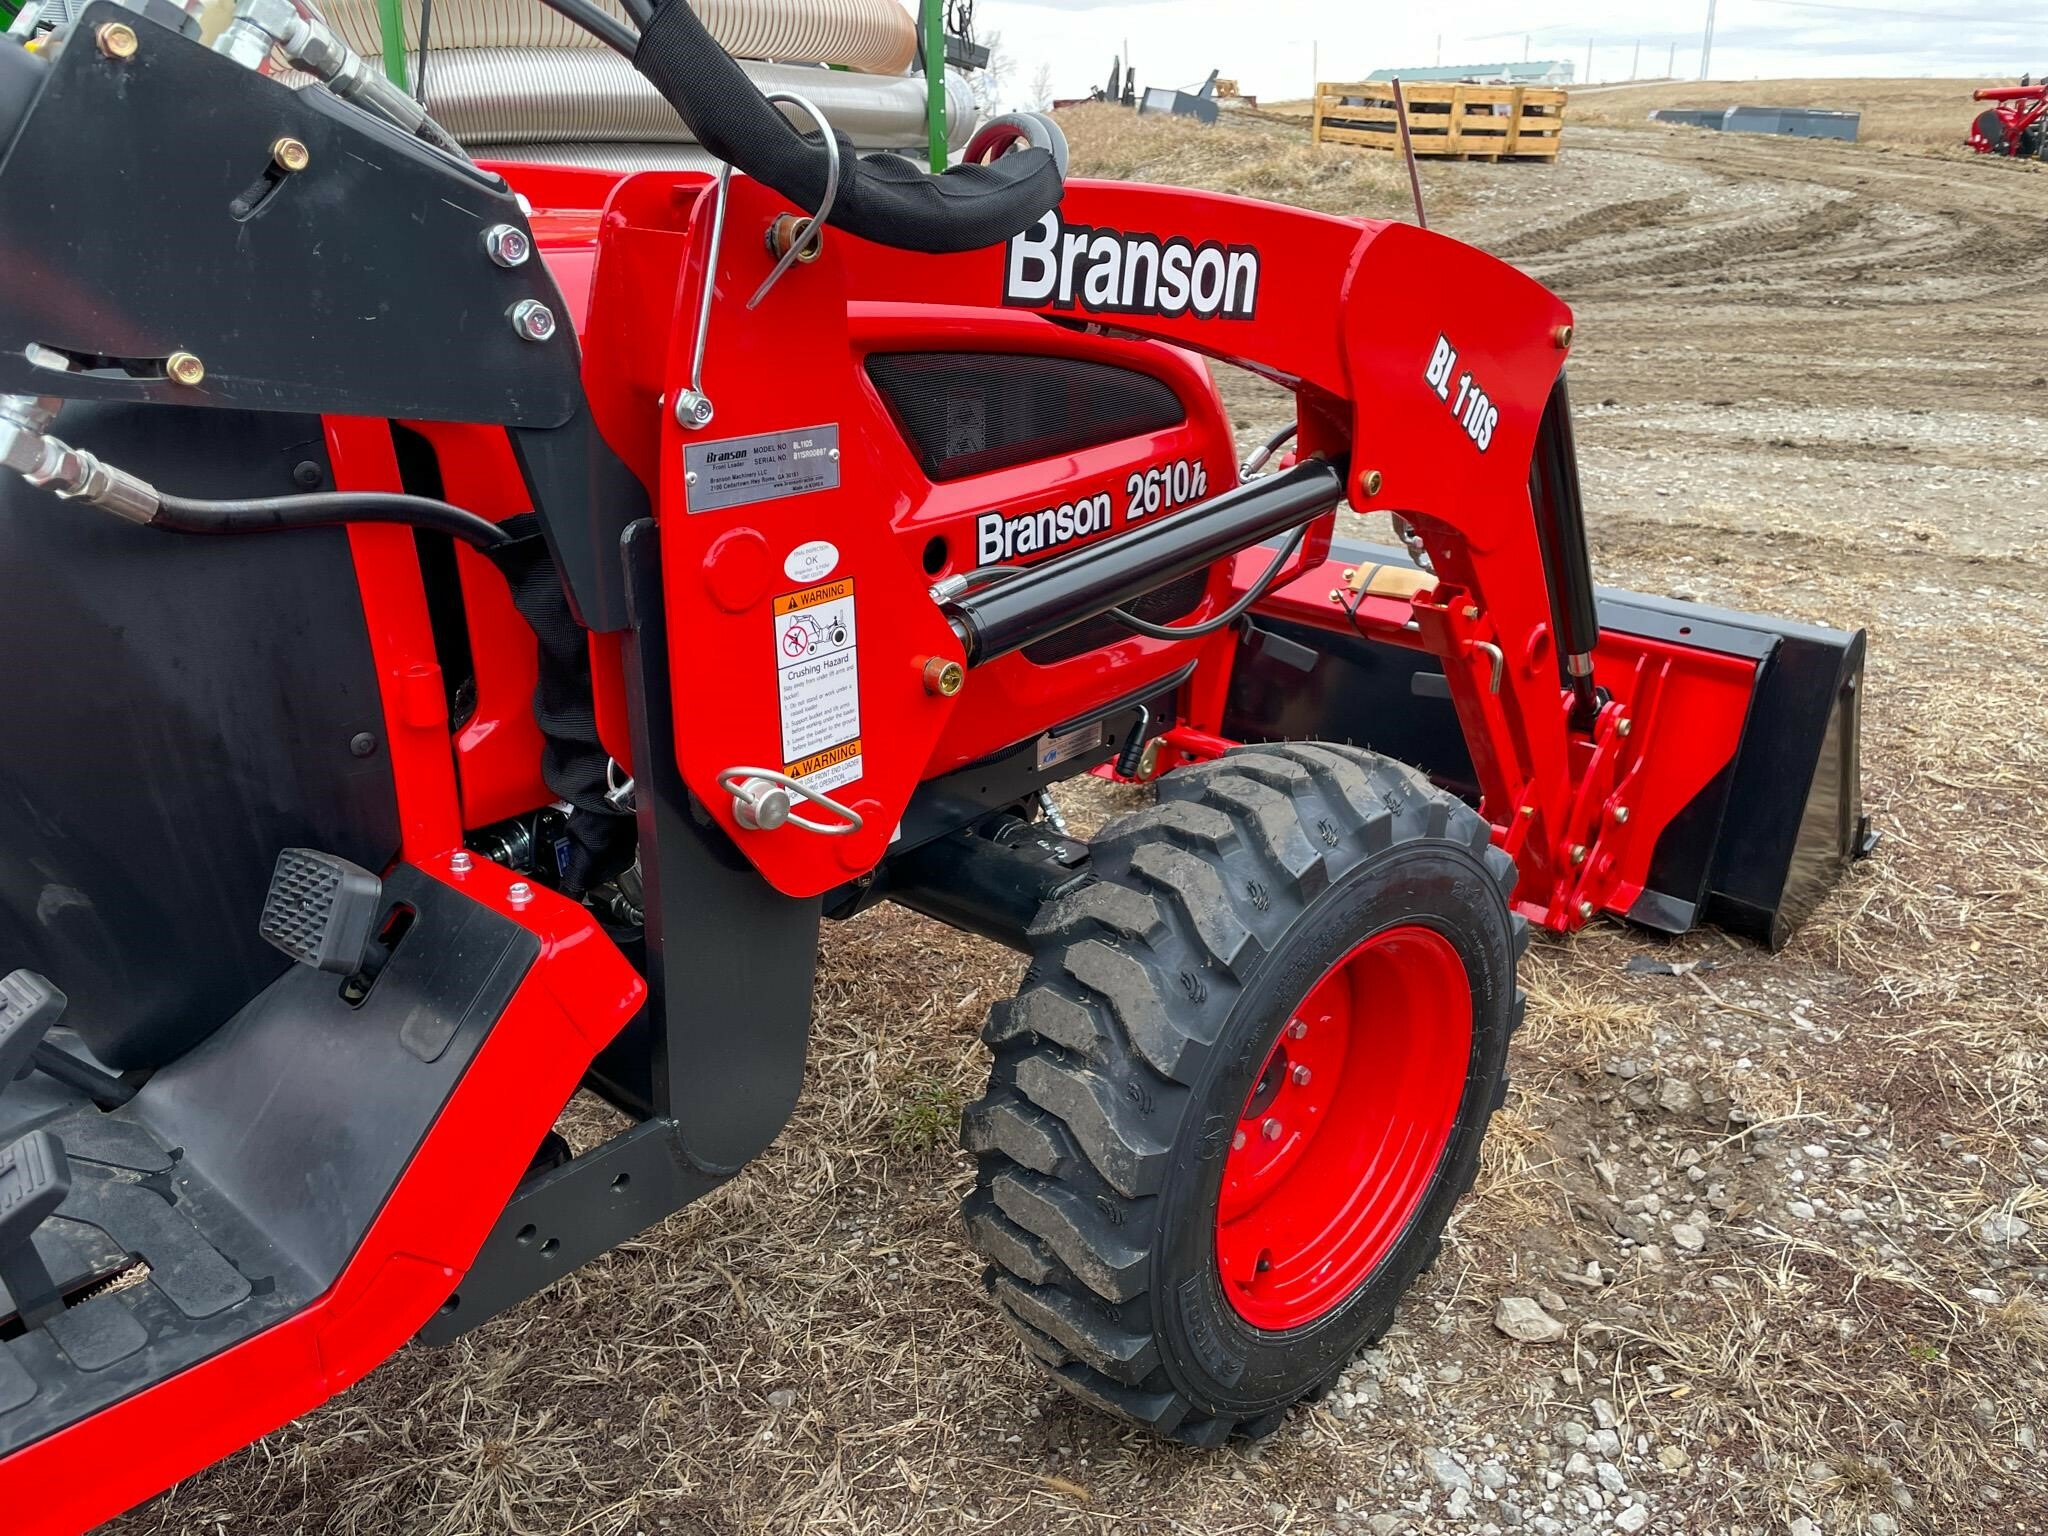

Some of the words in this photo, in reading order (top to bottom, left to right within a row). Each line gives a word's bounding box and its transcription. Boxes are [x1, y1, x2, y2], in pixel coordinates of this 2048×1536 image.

[1008, 209, 1257, 313] Branson
[1426, 335, 1457, 401] BL
[1453, 375, 1498, 451] 110S
[706, 450, 747, 463] Branson
[753, 445, 776, 454] MODEL
[754, 456, 776, 465] SERIAL
[979, 493, 1111, 565] Branson
[1127, 460, 1207, 520] 2610h
[806, 555, 818, 566] OK
[800, 584, 844, 605] WARNING
[788, 664, 820, 680] Crushing
[824, 653, 849, 670] Hazard
[802, 744, 856, 774] WARNING
